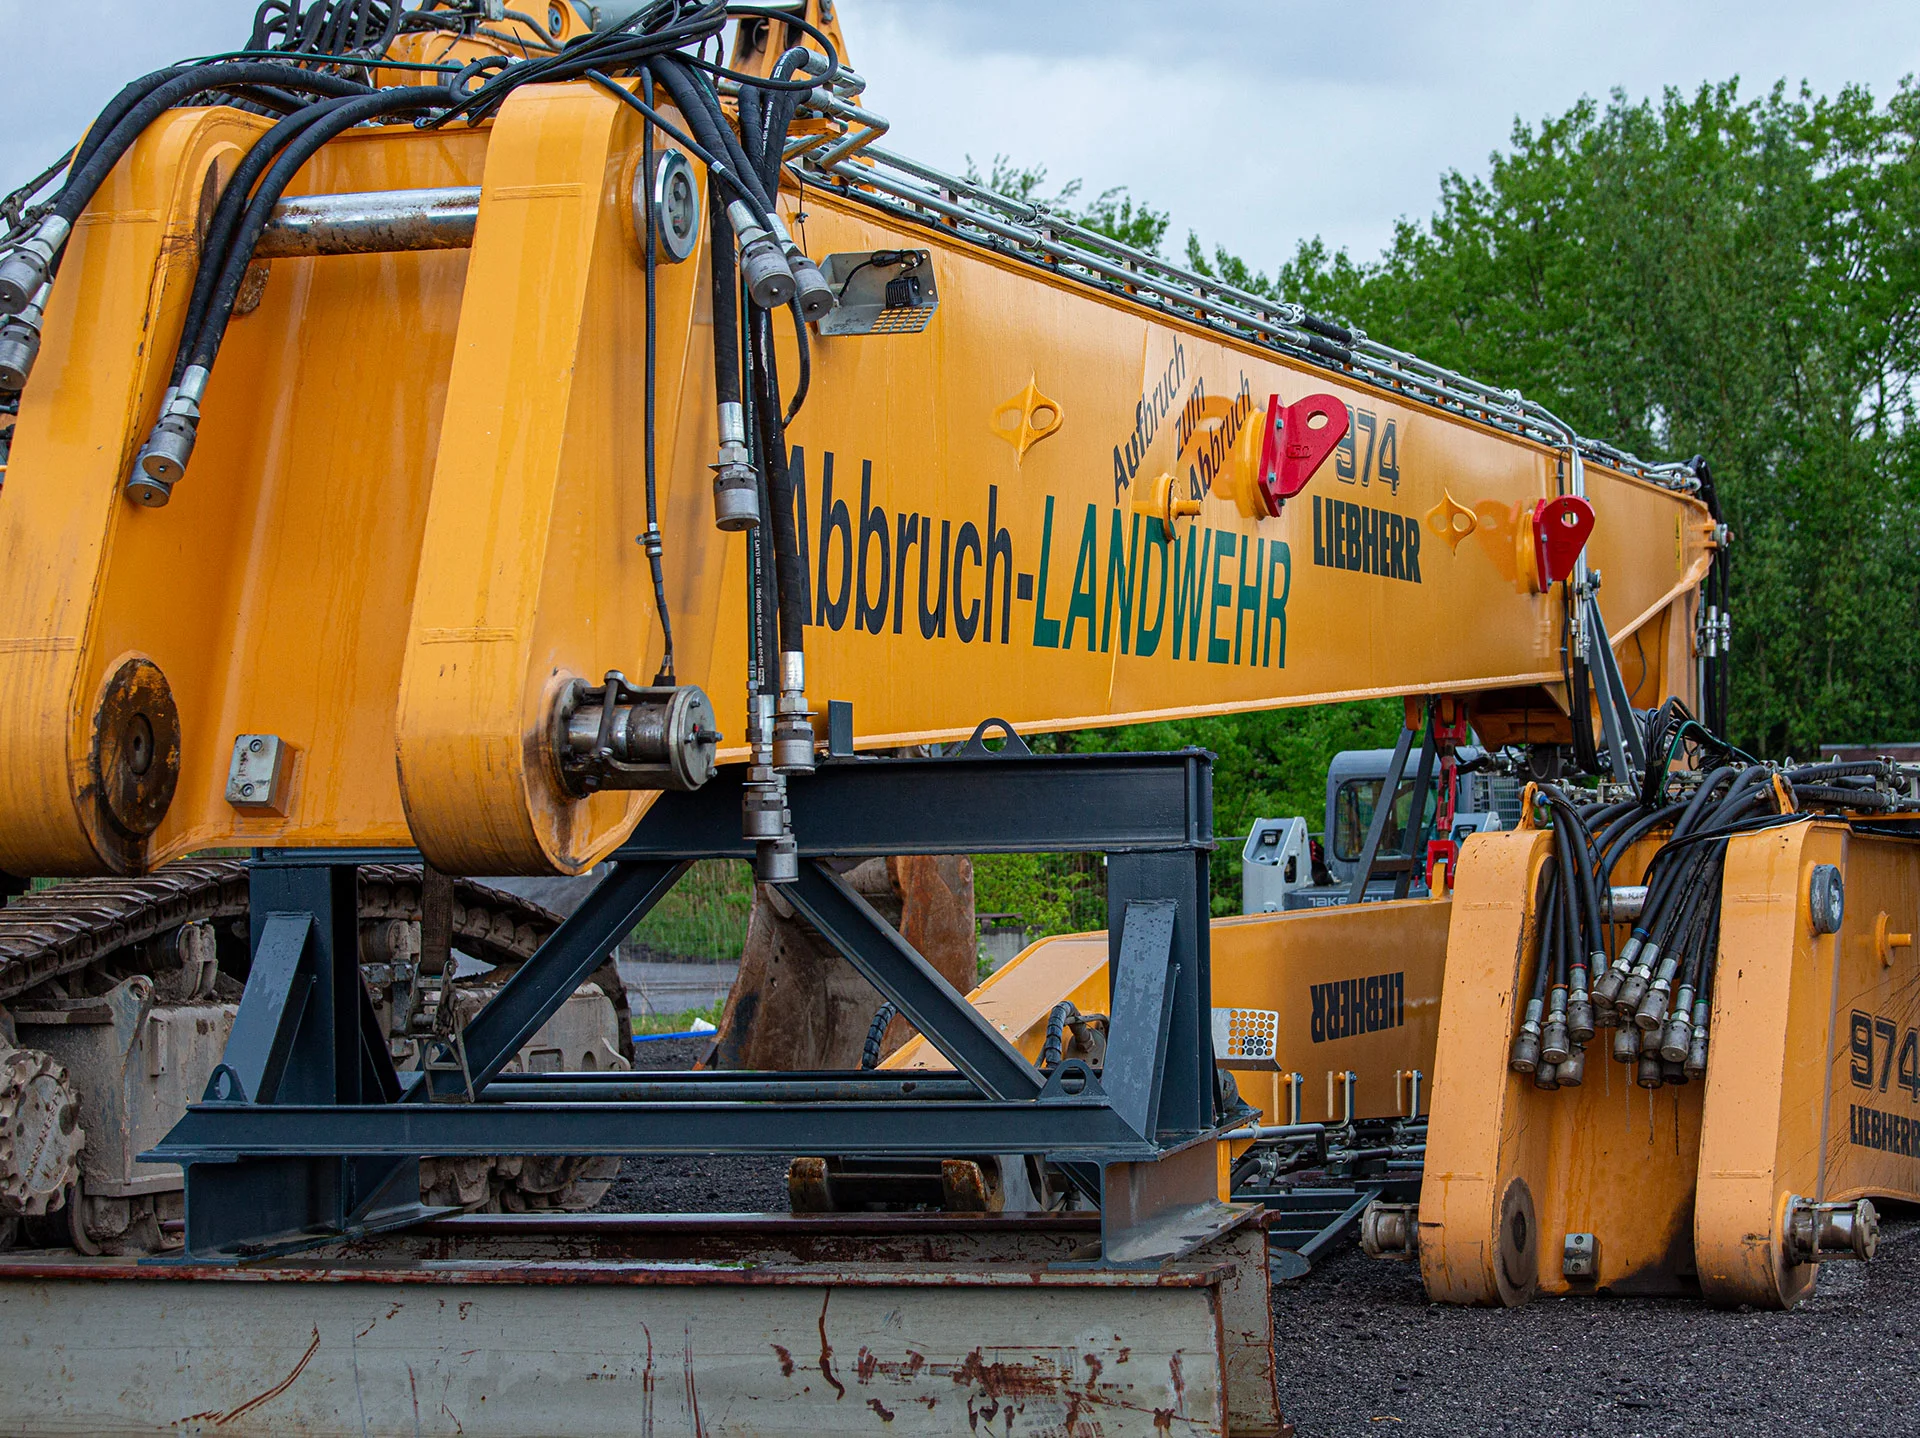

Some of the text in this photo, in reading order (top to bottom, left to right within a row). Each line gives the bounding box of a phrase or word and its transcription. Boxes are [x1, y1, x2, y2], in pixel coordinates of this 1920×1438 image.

[1112, 334, 1186, 506] Aufbruch
[1175, 376, 1205, 461] zum
[1190, 369, 1251, 521] Abbruch
[1336, 403, 1399, 496] 974
[1313, 495, 1422, 584] LIEBHERR
[1310, 971, 1404, 1043] LIEBHERR
[1850, 1008, 1920, 1103] 974
[1850, 1103, 1920, 1158] LIEBHERR
